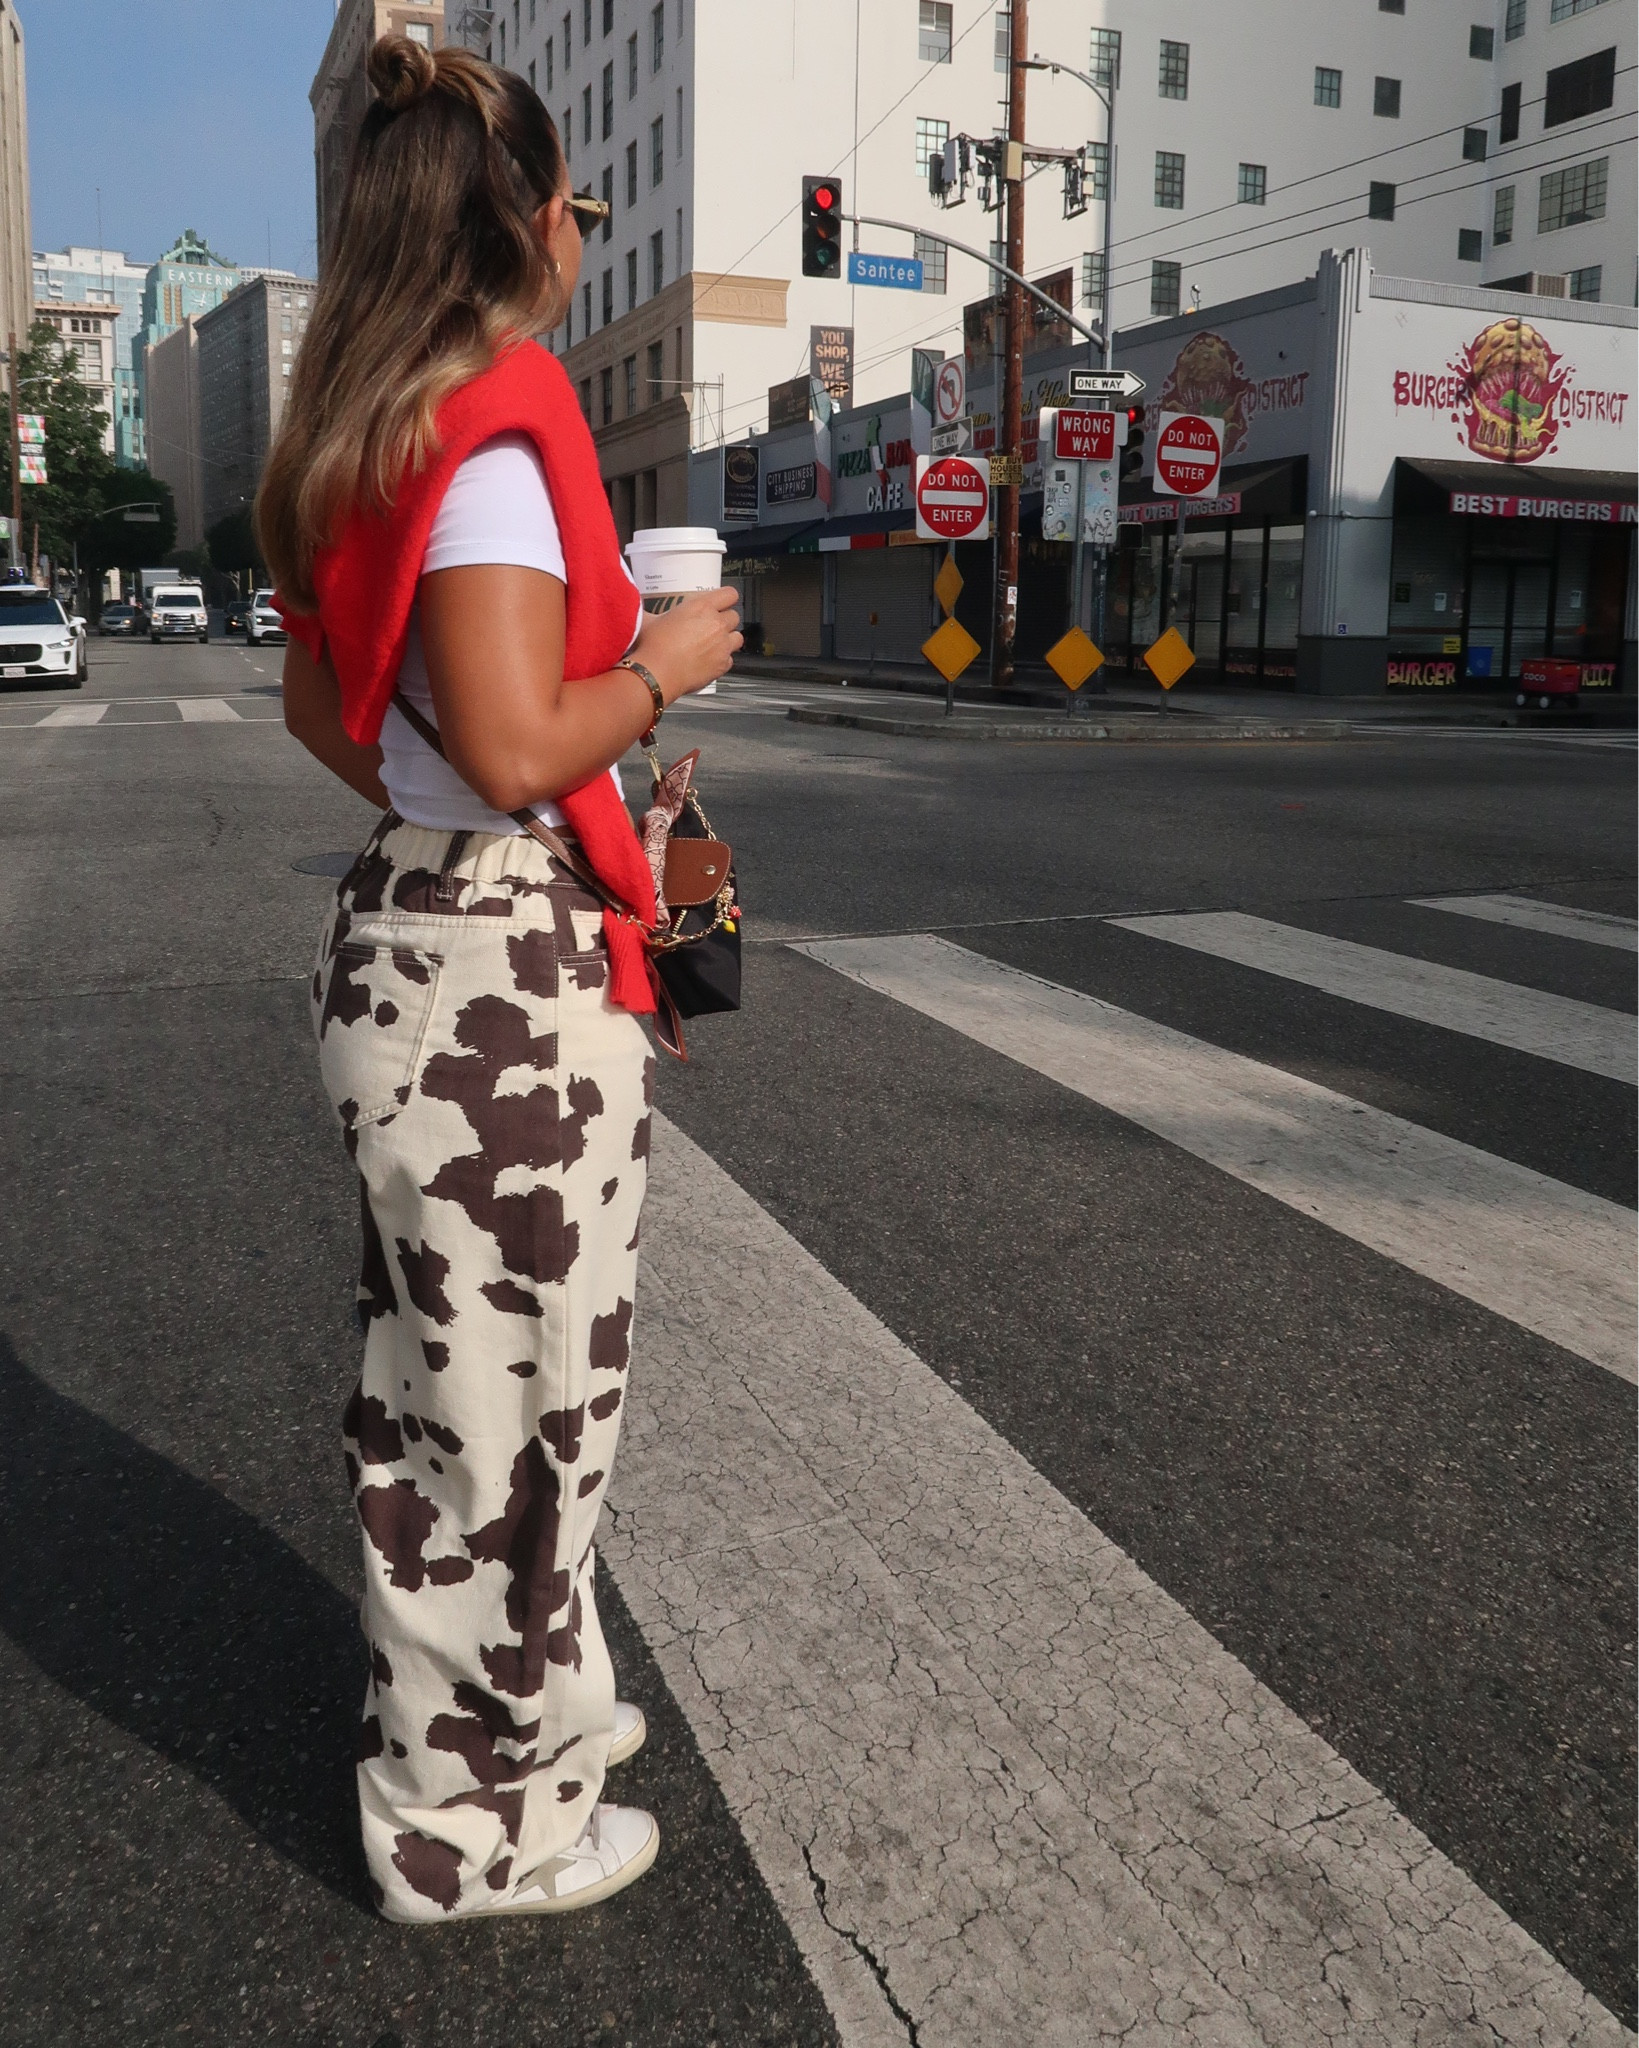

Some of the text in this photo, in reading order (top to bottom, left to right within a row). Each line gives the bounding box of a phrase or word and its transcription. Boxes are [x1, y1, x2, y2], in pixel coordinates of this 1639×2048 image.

[168, 269, 233, 286] EASTERN
[857, 260, 915, 282] Santee
[820, 330, 845, 345] YOU
[816, 344, 850, 363] SHOP,
[819, 361, 845, 380] WE
[1077, 379, 1122, 389] ONE WAY
[1246, 372, 1309, 414] DISTRICT
[1392, 370, 1629, 425] BURGER DISTRICT
[1062, 416, 1111, 434] WRONG
[934, 435, 945, 450] ONE
[946, 431, 959, 445] WAY
[1072, 436, 1099, 453] WAY
[1167, 429, 1213, 446] DO NOT
[837, 448, 872, 479] PIZZA
[1169, 465, 1205, 481] ENTER
[767, 466, 813, 486] CITY BUSINESS
[928, 473, 945, 486] DO
[952, 474, 977, 487] NOT
[774, 479, 806, 496] SHIPPING
[867, 483, 903, 512] CAFE
[933, 509, 973, 524] ENTER
[1144, 504, 1174, 520] OVER
[1185, 497, 1233, 516] URGERS
[1452, 494, 1509, 515] BEST
[1517, 498, 1612, 521] BURGERS
[1387, 662, 1456, 686] BURGER
